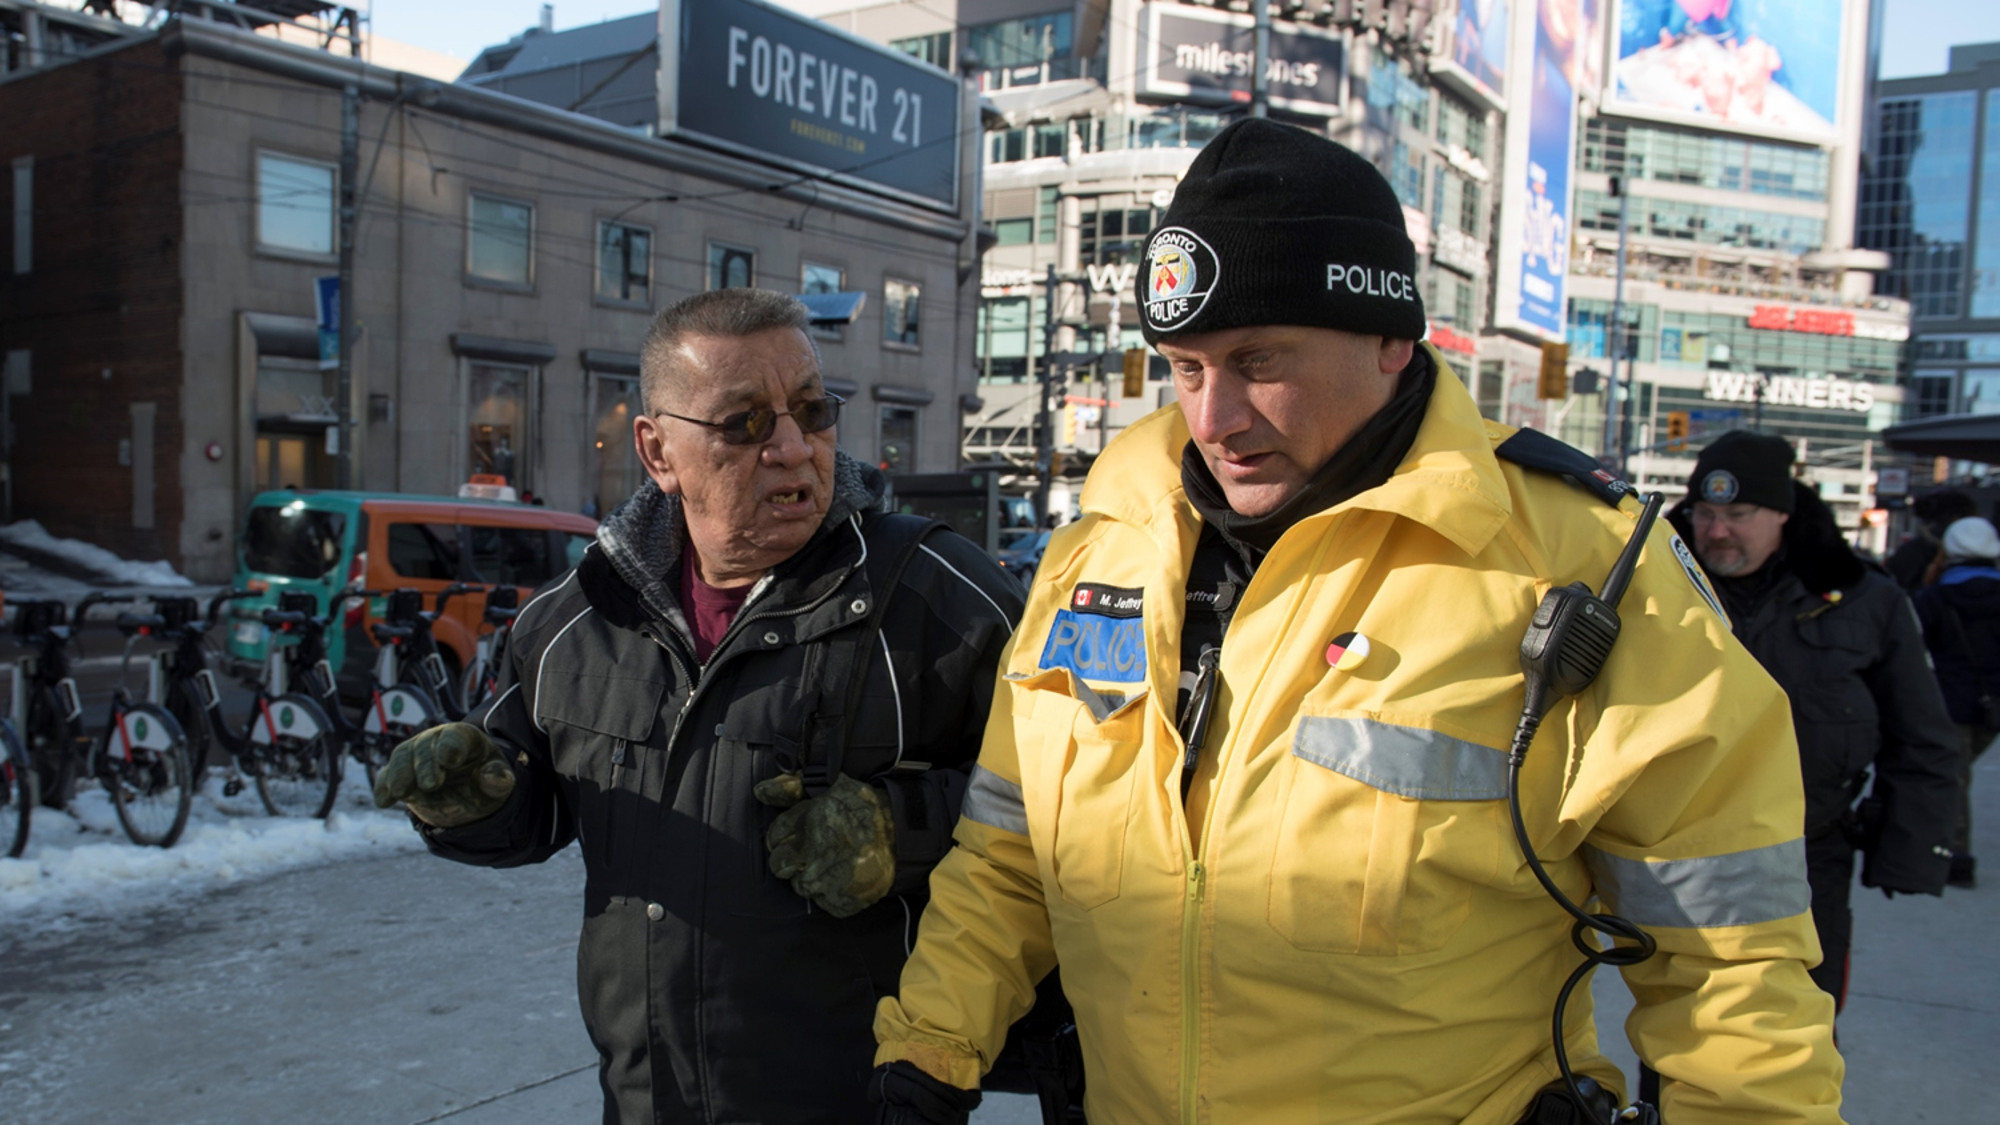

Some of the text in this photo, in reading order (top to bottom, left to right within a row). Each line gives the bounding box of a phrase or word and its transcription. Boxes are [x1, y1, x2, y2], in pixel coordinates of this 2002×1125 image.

[728, 26, 923, 148] FOREVER 21
[1327, 264, 1414, 301] POLICE
[1150, 298, 1189, 322] POLICE
[1706, 369, 1876, 412] WINNERS
[1100, 593, 1143, 610] M. Jeffrey
[1186, 590, 1221, 605] effrey
